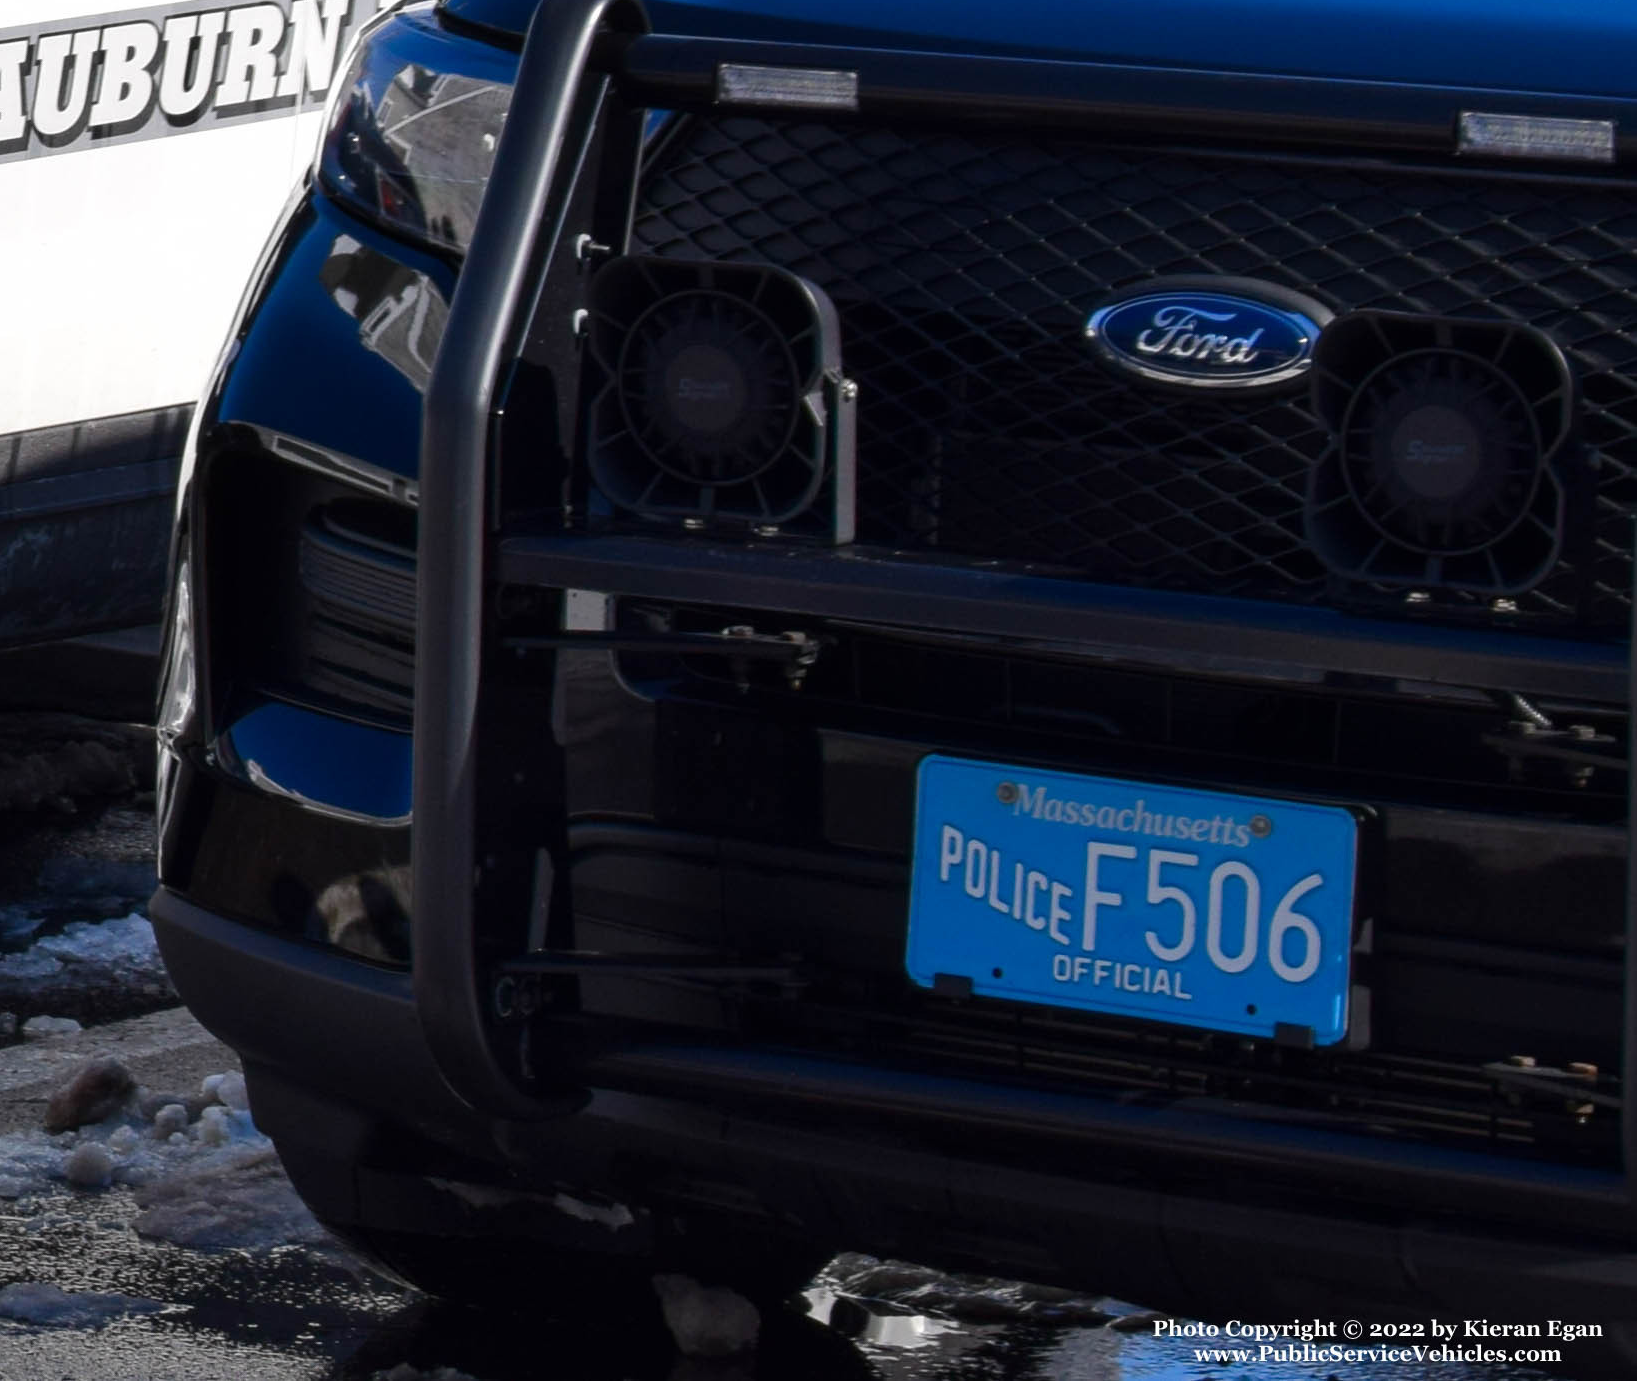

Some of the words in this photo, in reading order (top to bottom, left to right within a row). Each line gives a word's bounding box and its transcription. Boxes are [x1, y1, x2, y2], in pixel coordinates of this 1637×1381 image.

[1135, 305, 1266, 364] Ford
[1011, 782, 1252, 849] Massachusetts
[939, 824, 1073, 946] POLICE
[1081, 839, 1324, 983] F506
[1052, 953, 1193, 1001] OFFICIAL
